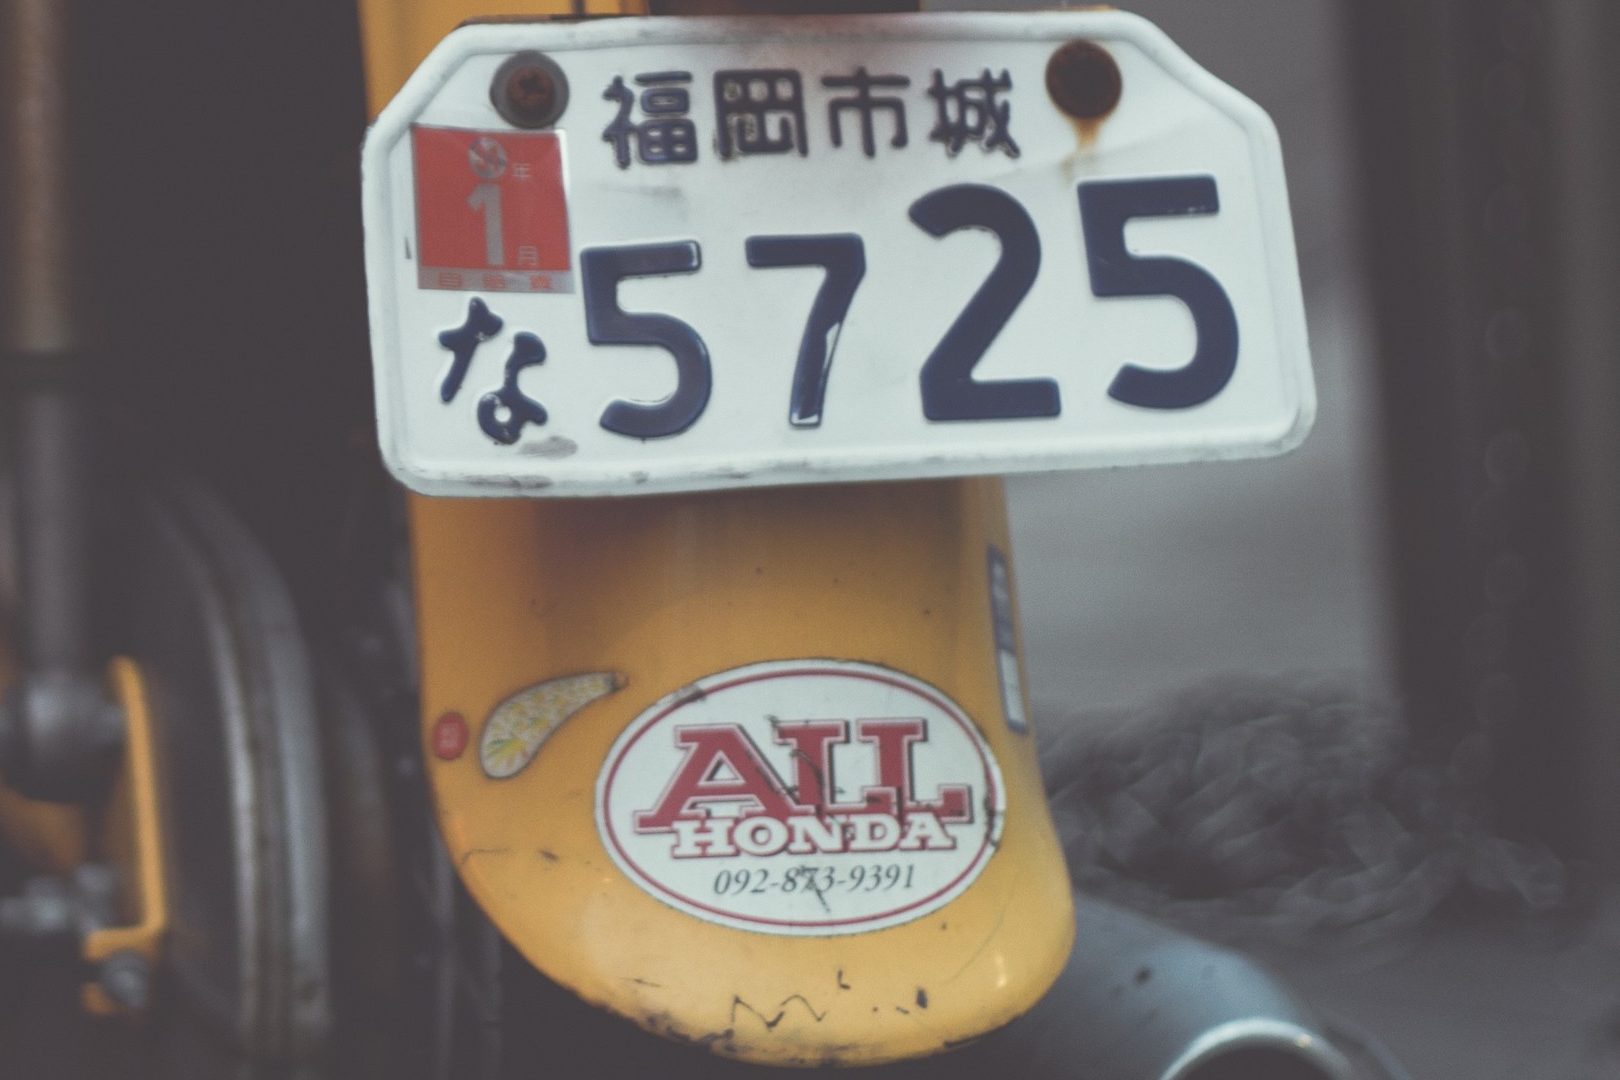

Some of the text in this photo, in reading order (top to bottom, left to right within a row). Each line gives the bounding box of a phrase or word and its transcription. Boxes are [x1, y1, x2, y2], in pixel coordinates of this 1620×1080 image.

[602, 66, 1021, 169] 福岡市城
[439, 174, 1240, 443] な 5725
[632, 717, 973, 834] ALL
[670, 812, 957, 859] HONDA
[713, 863, 915, 896] 092-873-9391
